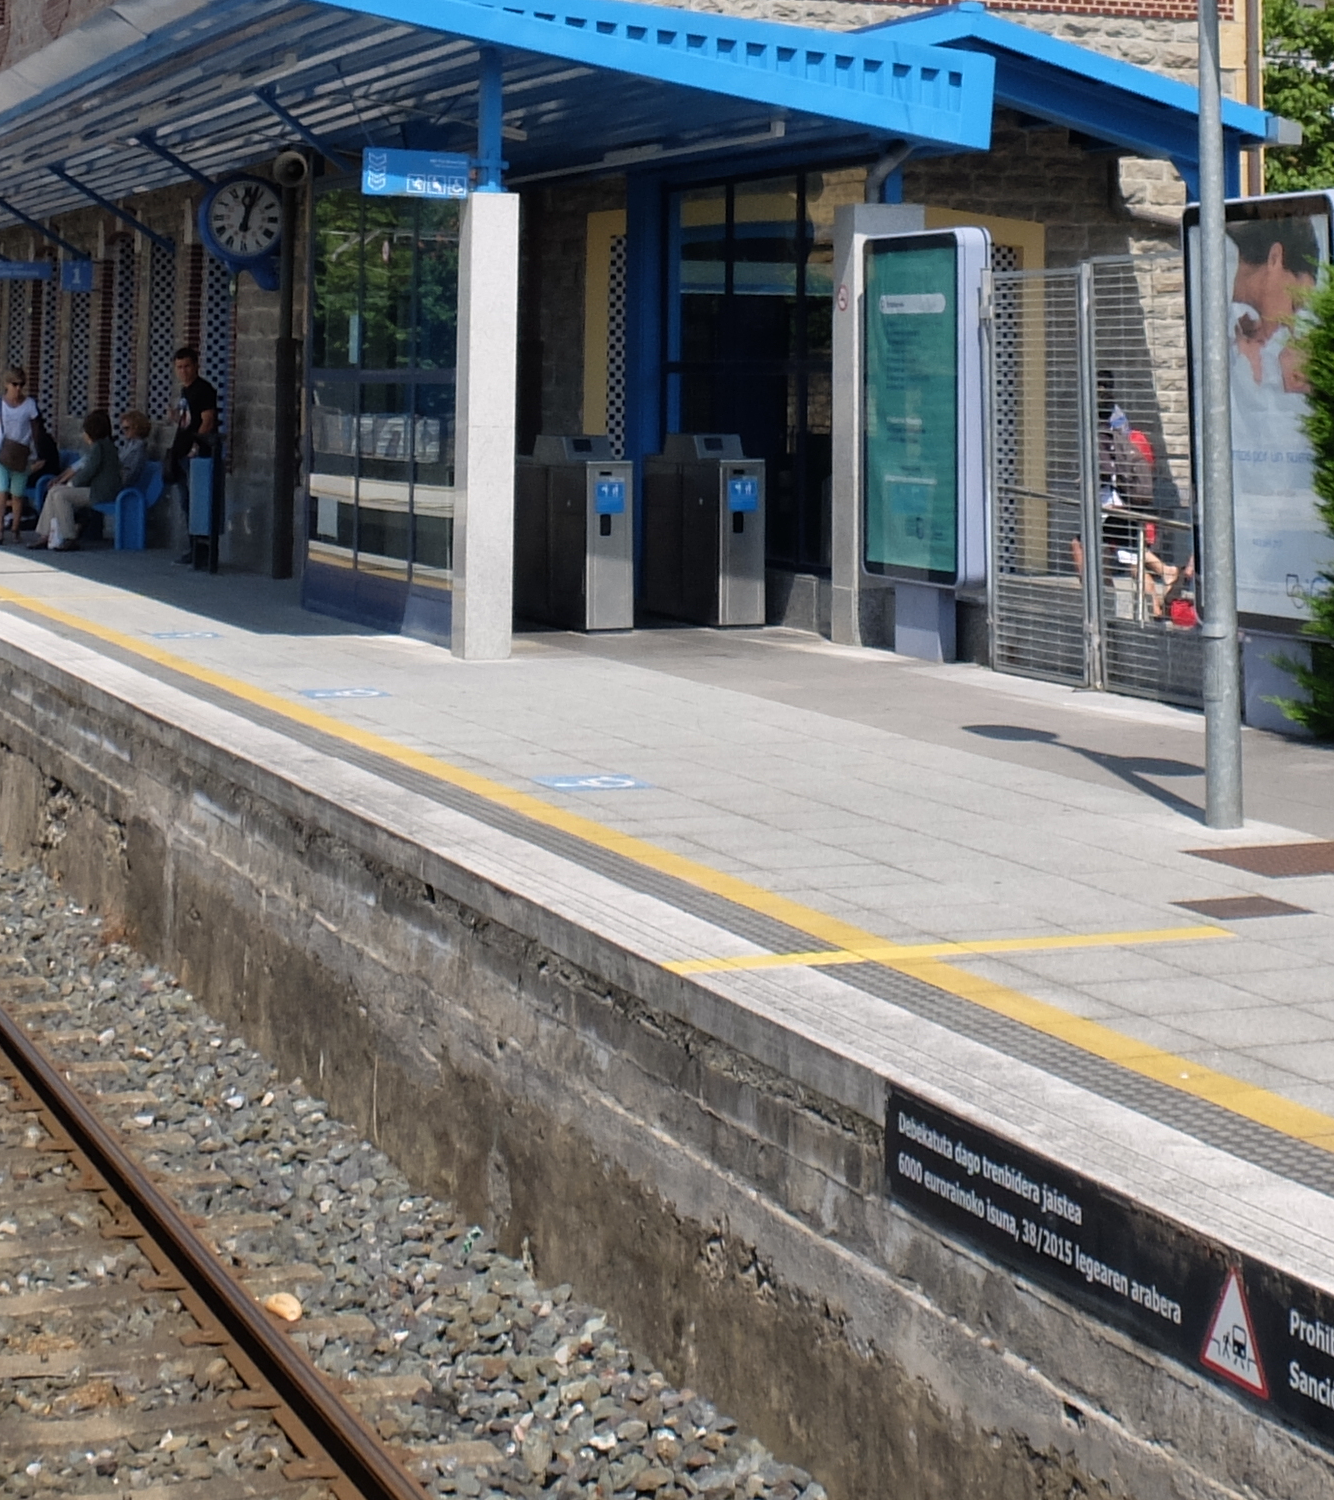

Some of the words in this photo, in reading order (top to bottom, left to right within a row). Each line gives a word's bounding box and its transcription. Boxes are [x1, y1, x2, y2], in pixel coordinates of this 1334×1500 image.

[898, 1112, 953, 1160] Debekatuta
[954, 1140, 980, 1177] dago
[983, 1155, 1039, 1204] trenbidera
[1040, 1183, 1082, 1226] jaistea
[898, 1152, 922, 1185] 6000
[924, 1168, 984, 1219] eurorainoko
[987, 1199, 1019, 1241] isuna,
[1022, 1219, 1072, 1266] 38/2015
[1076, 1246, 1128, 1296] legearen
[1131, 1279, 1181, 1325] arabera
